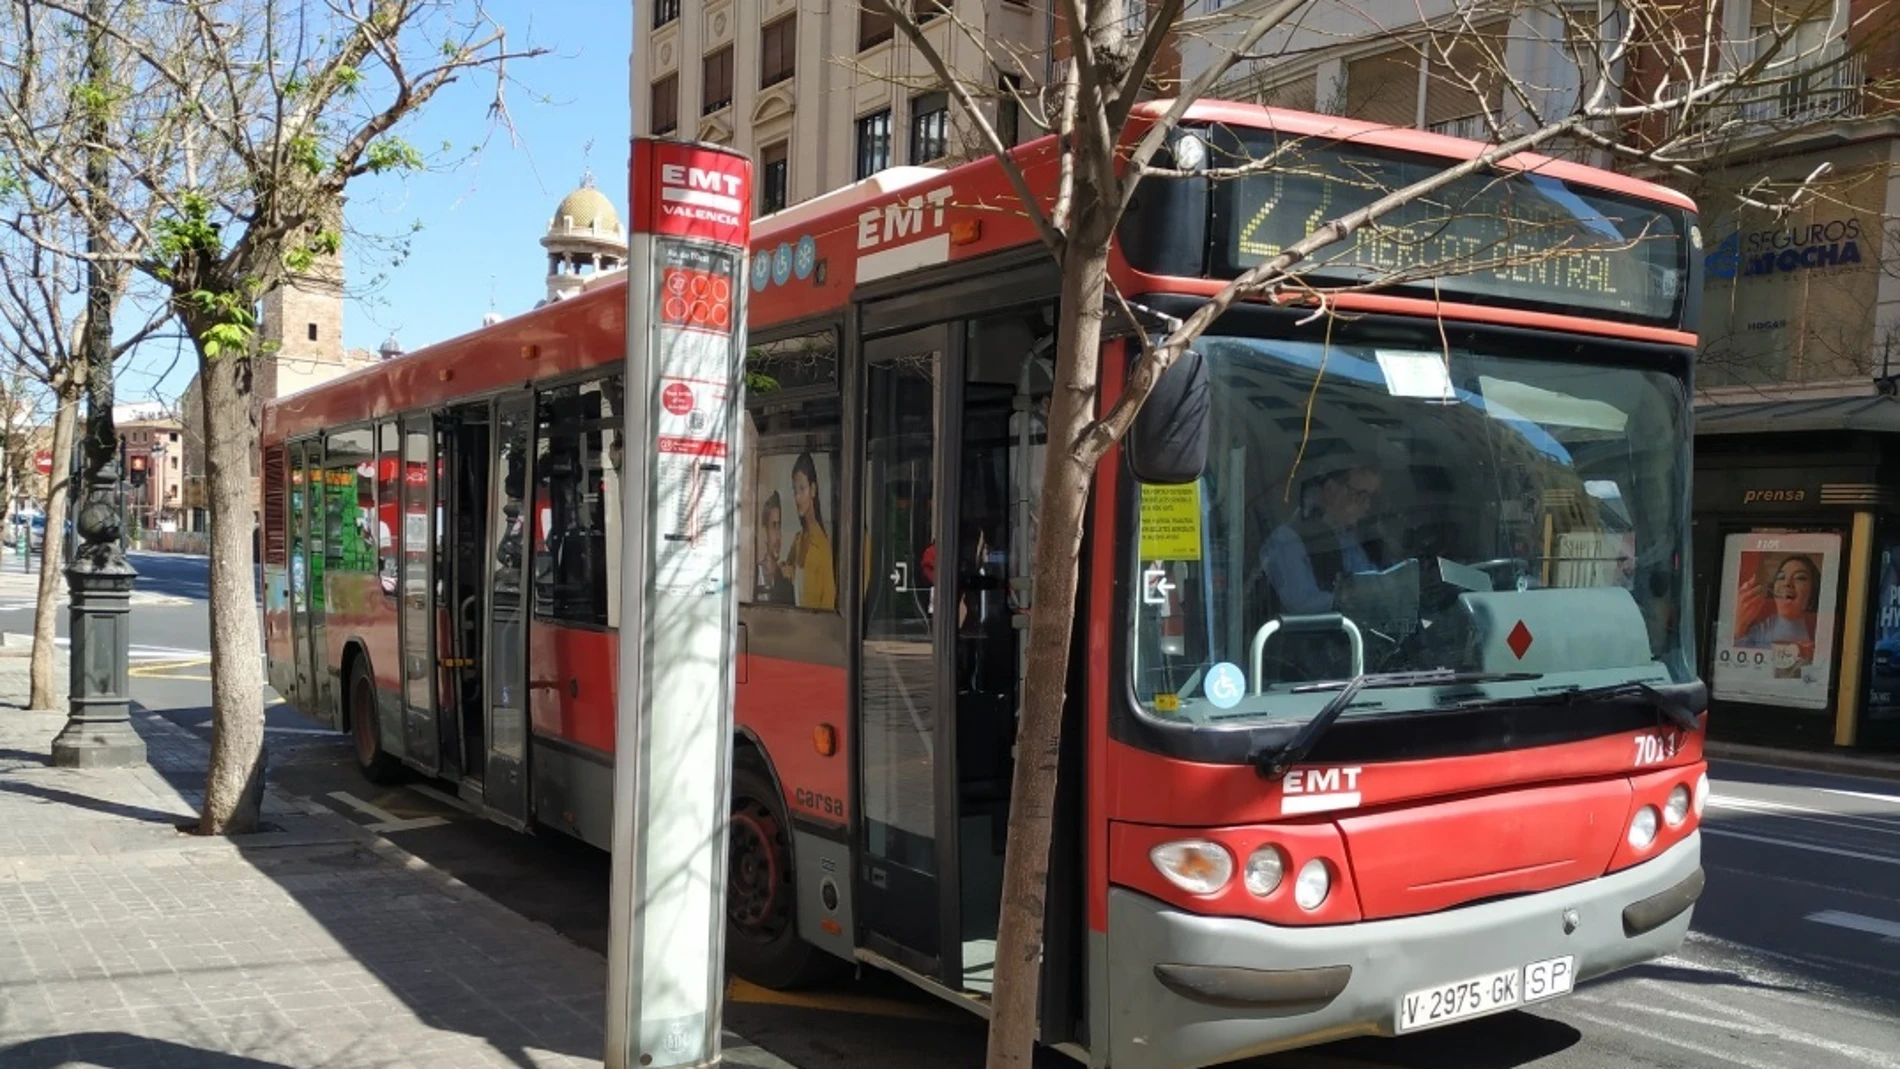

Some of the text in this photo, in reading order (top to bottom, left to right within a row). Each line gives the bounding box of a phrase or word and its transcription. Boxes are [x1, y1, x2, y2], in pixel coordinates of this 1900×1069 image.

[661, 164, 743, 196] EMT
[662, 204, 740, 226] VALENCIA
[857, 185, 954, 250] EMT
[1492, 243, 1617, 294] CENTRAL
[1743, 490, 1806, 504] prensa
[1282, 767, 1362, 794] EMT
[796, 787, 844, 817] carsa
[1531, 962, 1566, 994] SP
